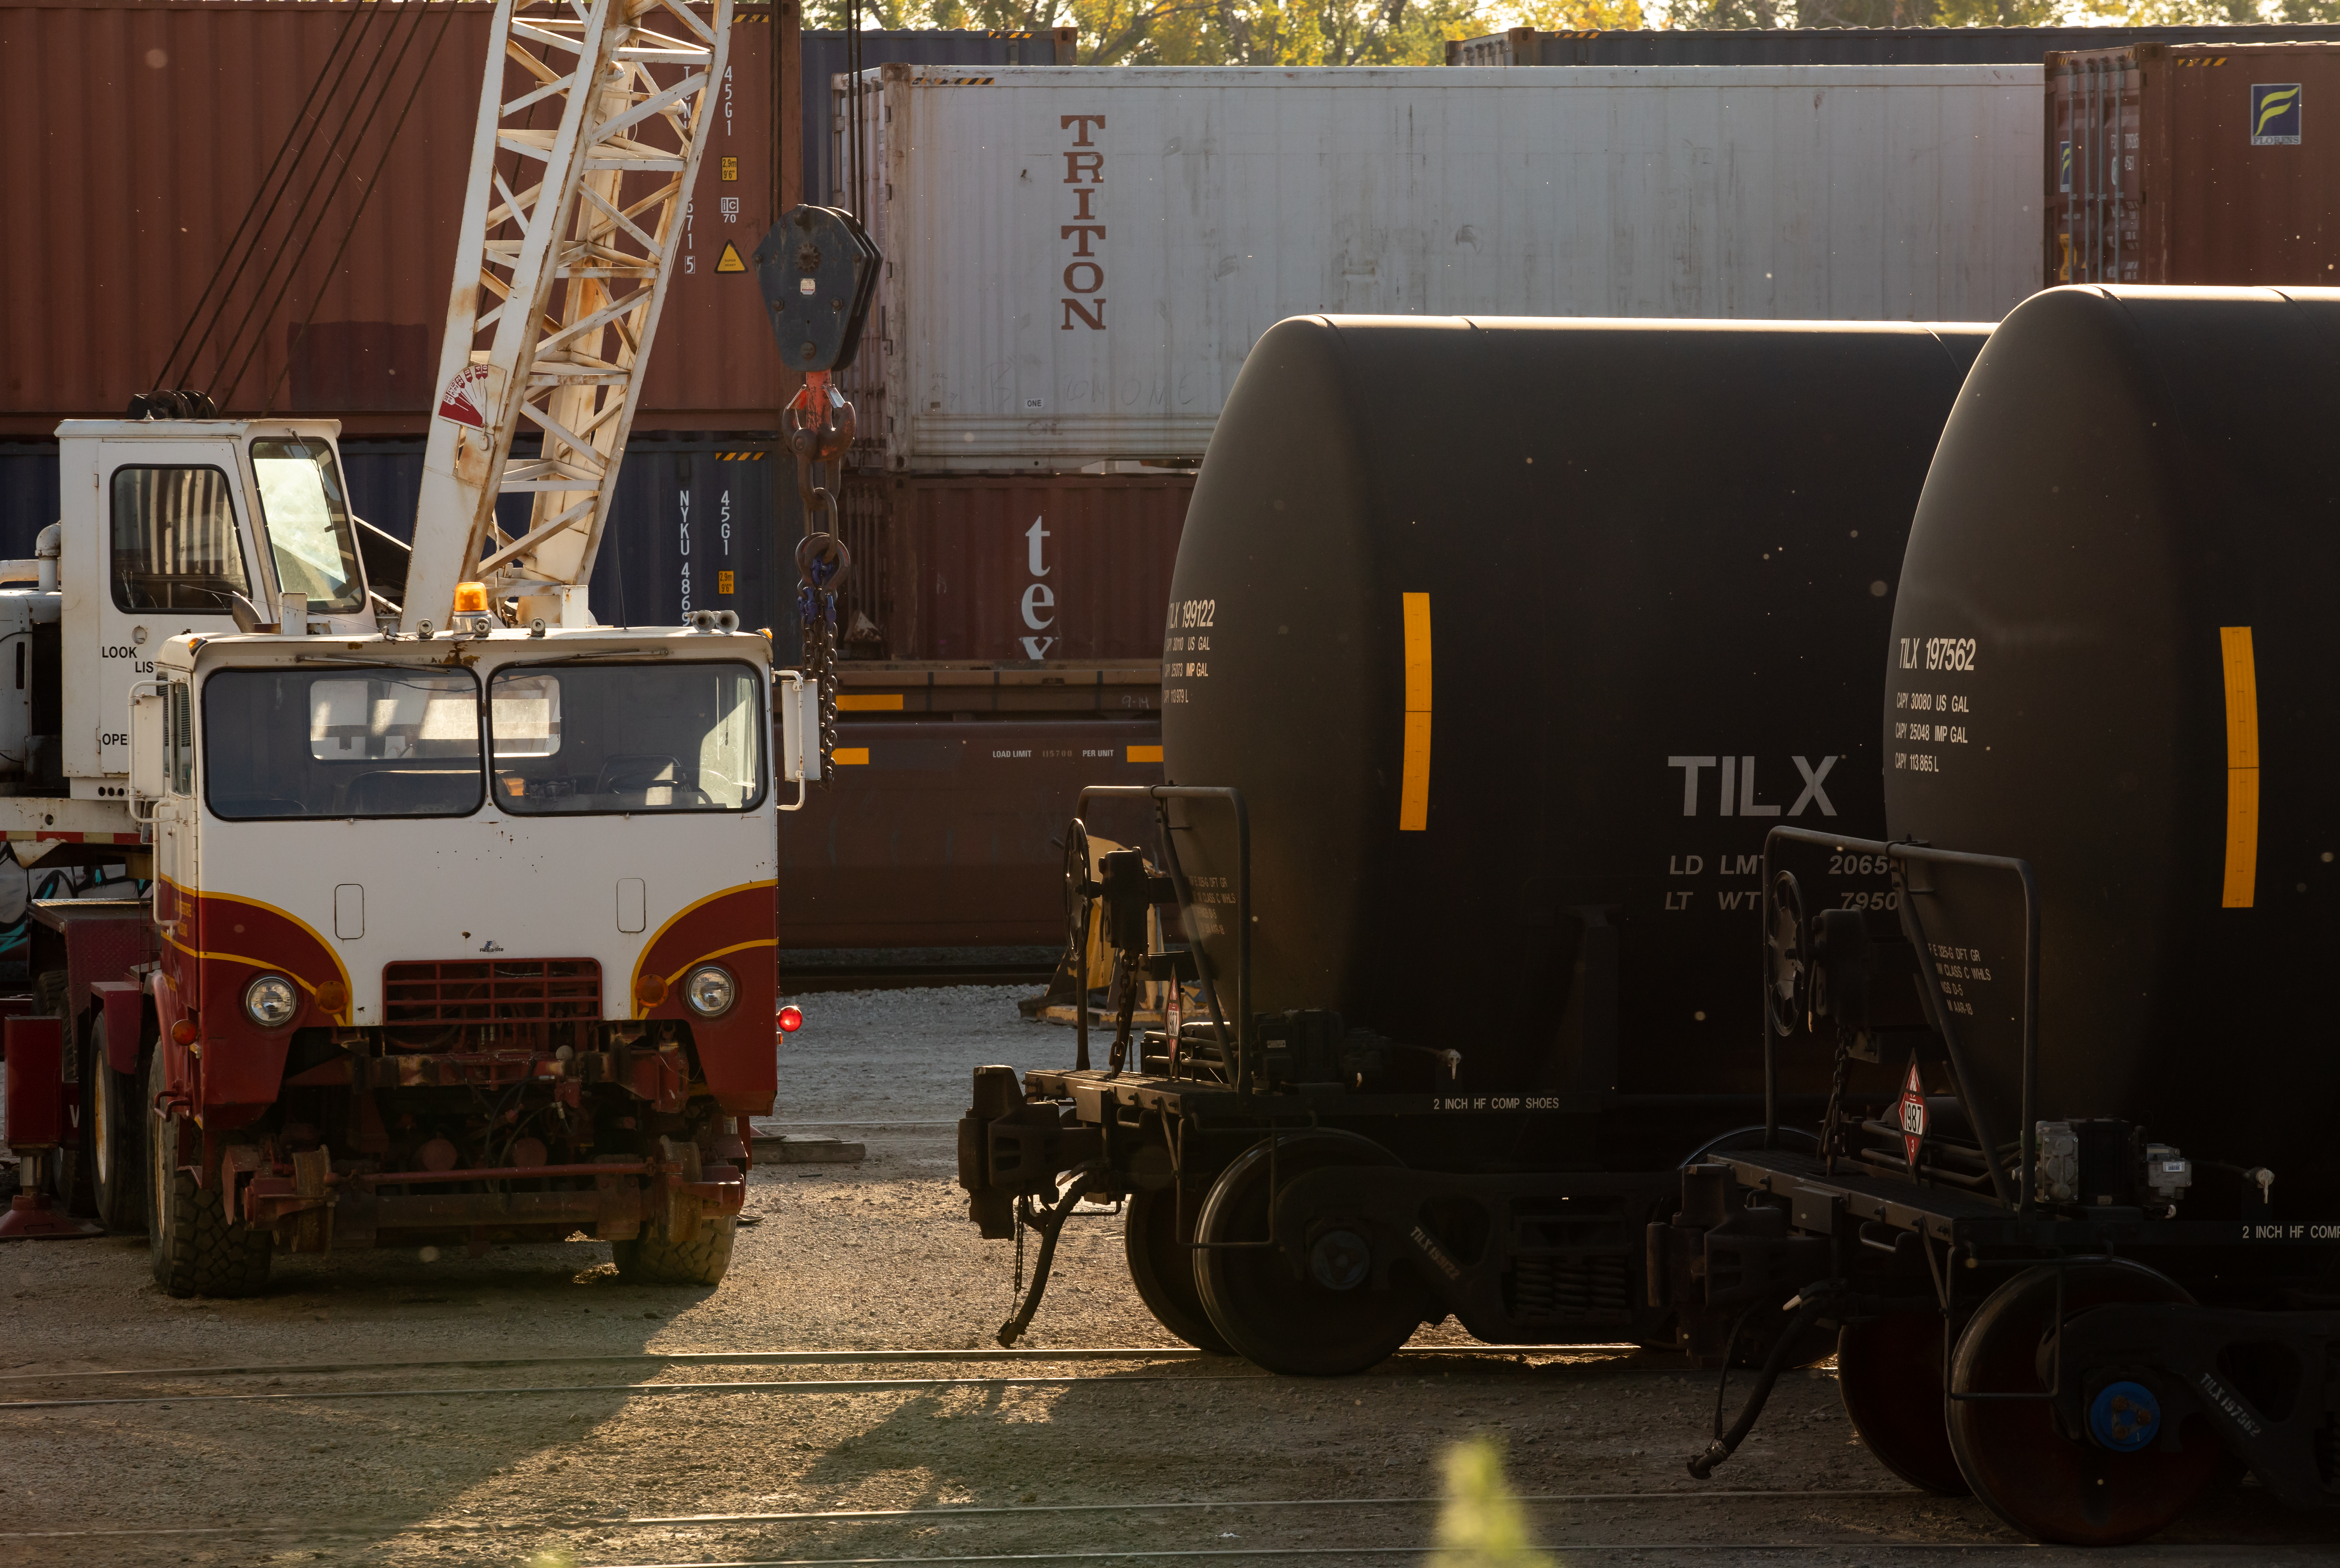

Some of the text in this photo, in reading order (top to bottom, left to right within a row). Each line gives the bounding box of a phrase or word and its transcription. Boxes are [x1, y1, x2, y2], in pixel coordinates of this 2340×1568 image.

[723, 214, 736, 223] 70
[1061, 115, 1106, 330] TRITON
[465, 369, 472, 379] 18
[476, 366, 481, 375] 14
[451, 382, 459, 391] 26
[456, 376, 464, 386] 22
[680, 490, 690, 555] NYKU
[721, 490, 730, 555] 45G1
[1168, 599, 1215, 629] TILX 199122
[102, 646, 137, 658] LOOK
[1173, 637, 1184, 651] 30110
[1188, 636, 1195, 650] US
[1198, 636, 1210, 650] GAL
[1900, 638, 1976, 671] TILX 197562
[135, 661, 155, 673] LIS
[1171, 663, 1183, 677] 25073
[1186, 663, 1195, 676] IMP
[1196, 662, 1208, 677] GAL
[1122, 695, 1149, 708] 9-14
[1897, 692, 1969, 712] CAPY 30080 US GAL
[102, 733, 129, 745] OPE
[1896, 722, 1968, 743] CAPY 25048 IMP GAL
[1895, 752, 1906, 769] CAPY
[1935, 756, 1939, 772] L
[1668, 756, 1838, 816] TILX
[1669, 855, 1703, 875] LD
[1720, 855, 1764, 875] LM
[1220, 877, 1228, 888] GR
[1665, 892, 1693, 910] LT
[1719, 892, 1761, 910] WT
[1938, 945, 1954, 959] 325-G
[1955, 948, 1967, 960] DFT
[1971, 949, 1980, 962] GR
[1944, 964, 1962, 978] CLASS
[1964, 967, 1969, 979] C
[1971, 968, 1991, 981] WHLS
[1952, 983, 1963, 996] D-5
[1168, 1011, 1178, 1036] 1987
[1434, 1097, 1559, 1110] 2 INCH HF COMP SHOES
[1906, 1103, 1921, 1133] 1987
[1911, 1139, 1914, 1153] 3
[1410, 1226, 1433, 1251] TILX
[2243, 1226, 2249, 1238] 2
[2256, 1225, 2282, 1238] INCH
[2290, 1225, 2304, 1238] HF
[2200, 1373, 2225, 1400] TILX
